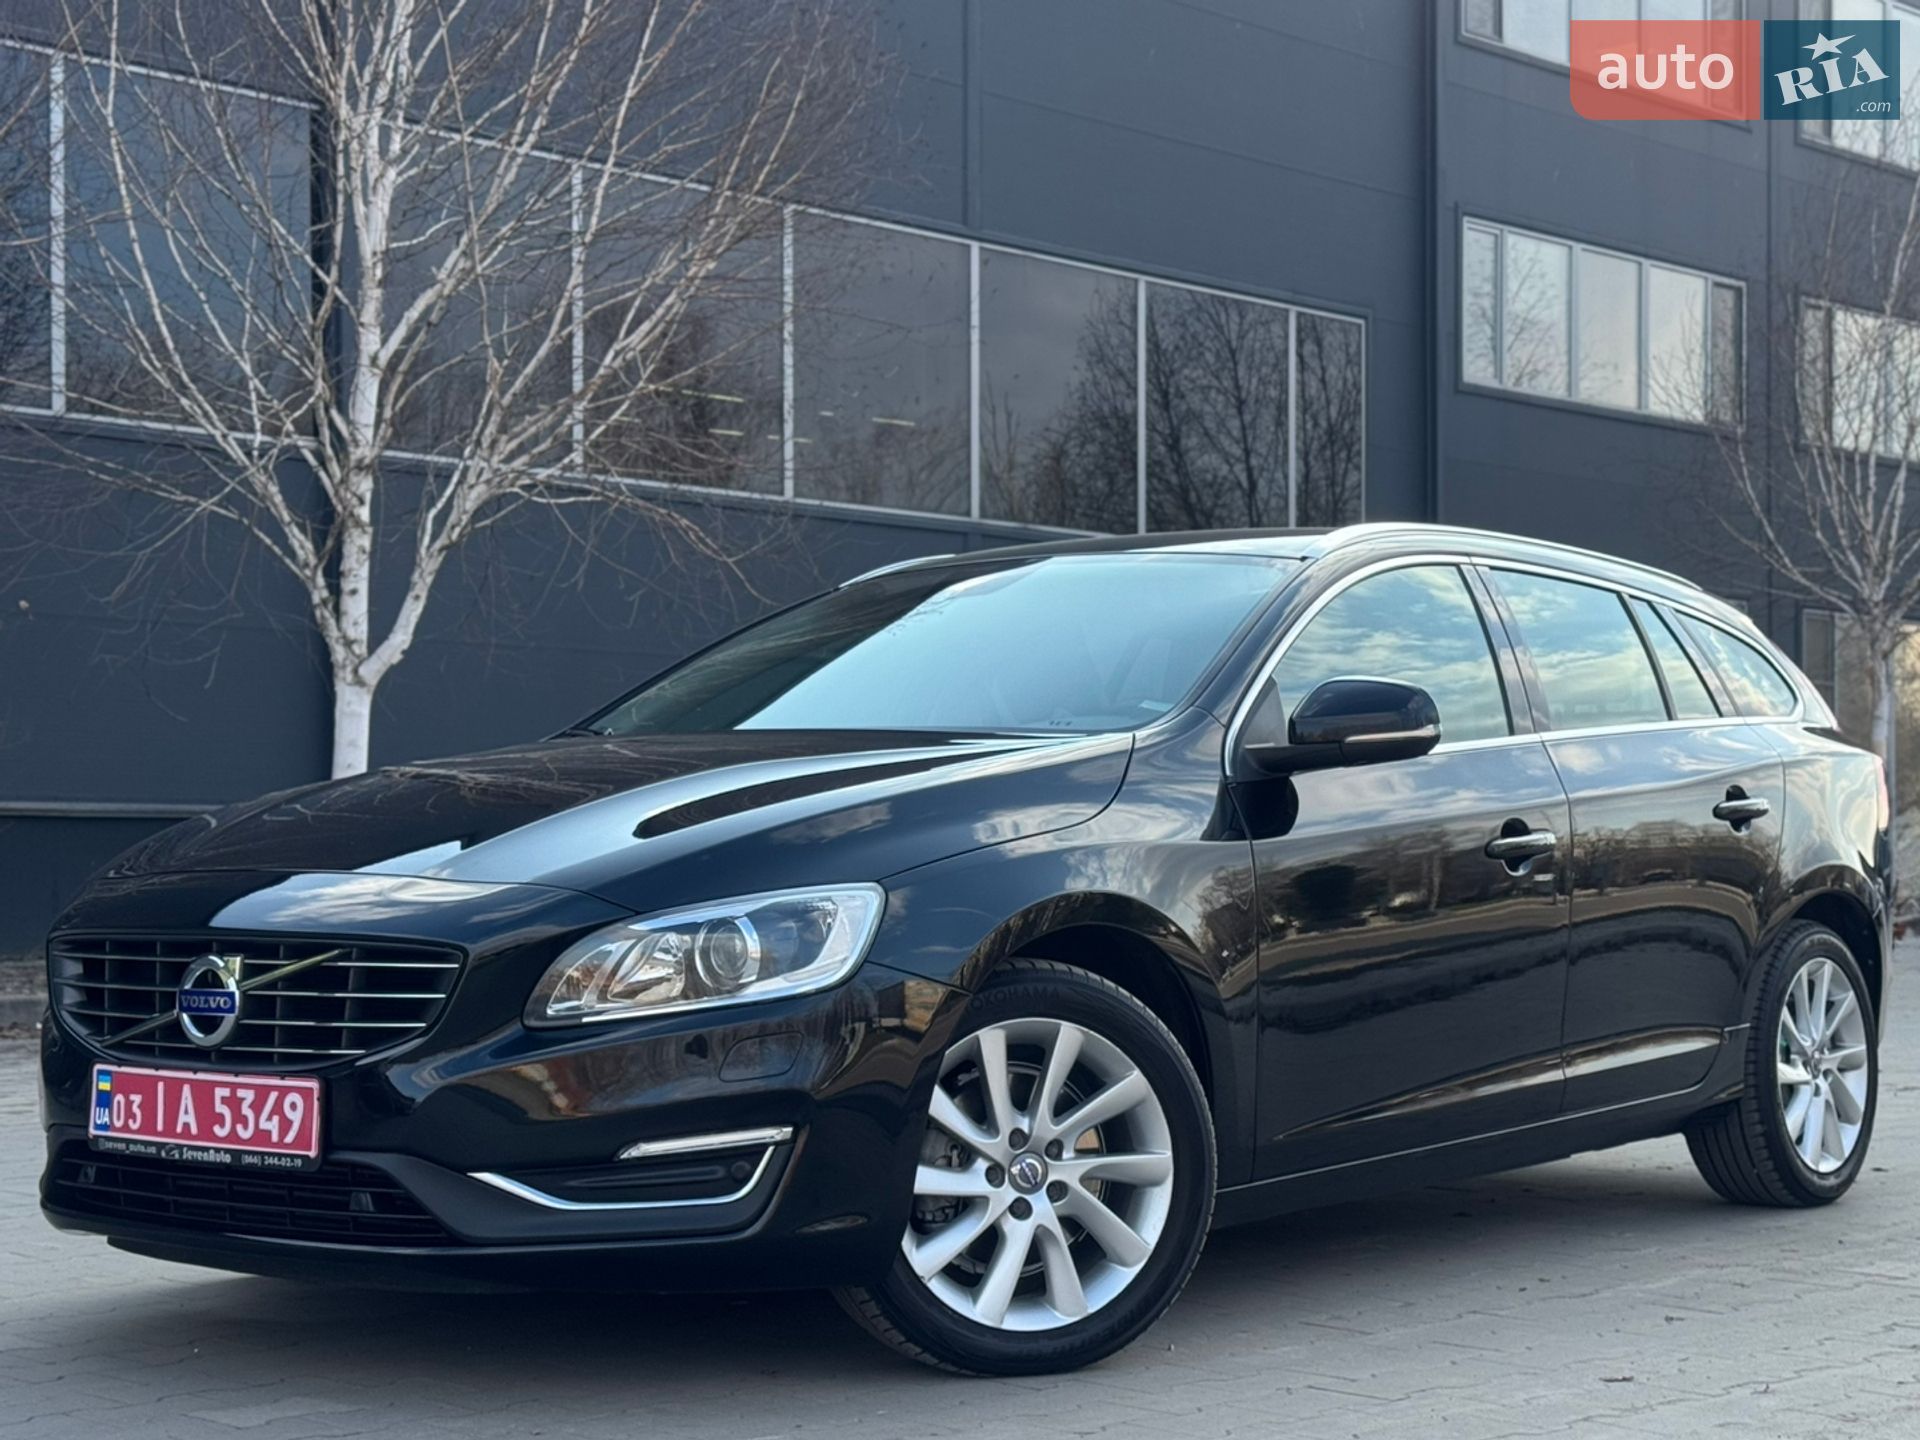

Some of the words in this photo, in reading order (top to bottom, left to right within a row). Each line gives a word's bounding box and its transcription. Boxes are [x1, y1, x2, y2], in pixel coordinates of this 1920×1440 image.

[181, 994, 232, 1010] VOLVO
[969, 985, 1061, 1010] OKOHAMA
[95, 1107, 111, 1126] UA
[112, 1093, 143, 1131] 03
[157, 1081, 199, 1136] IA
[212, 1086, 305, 1145] 5349
